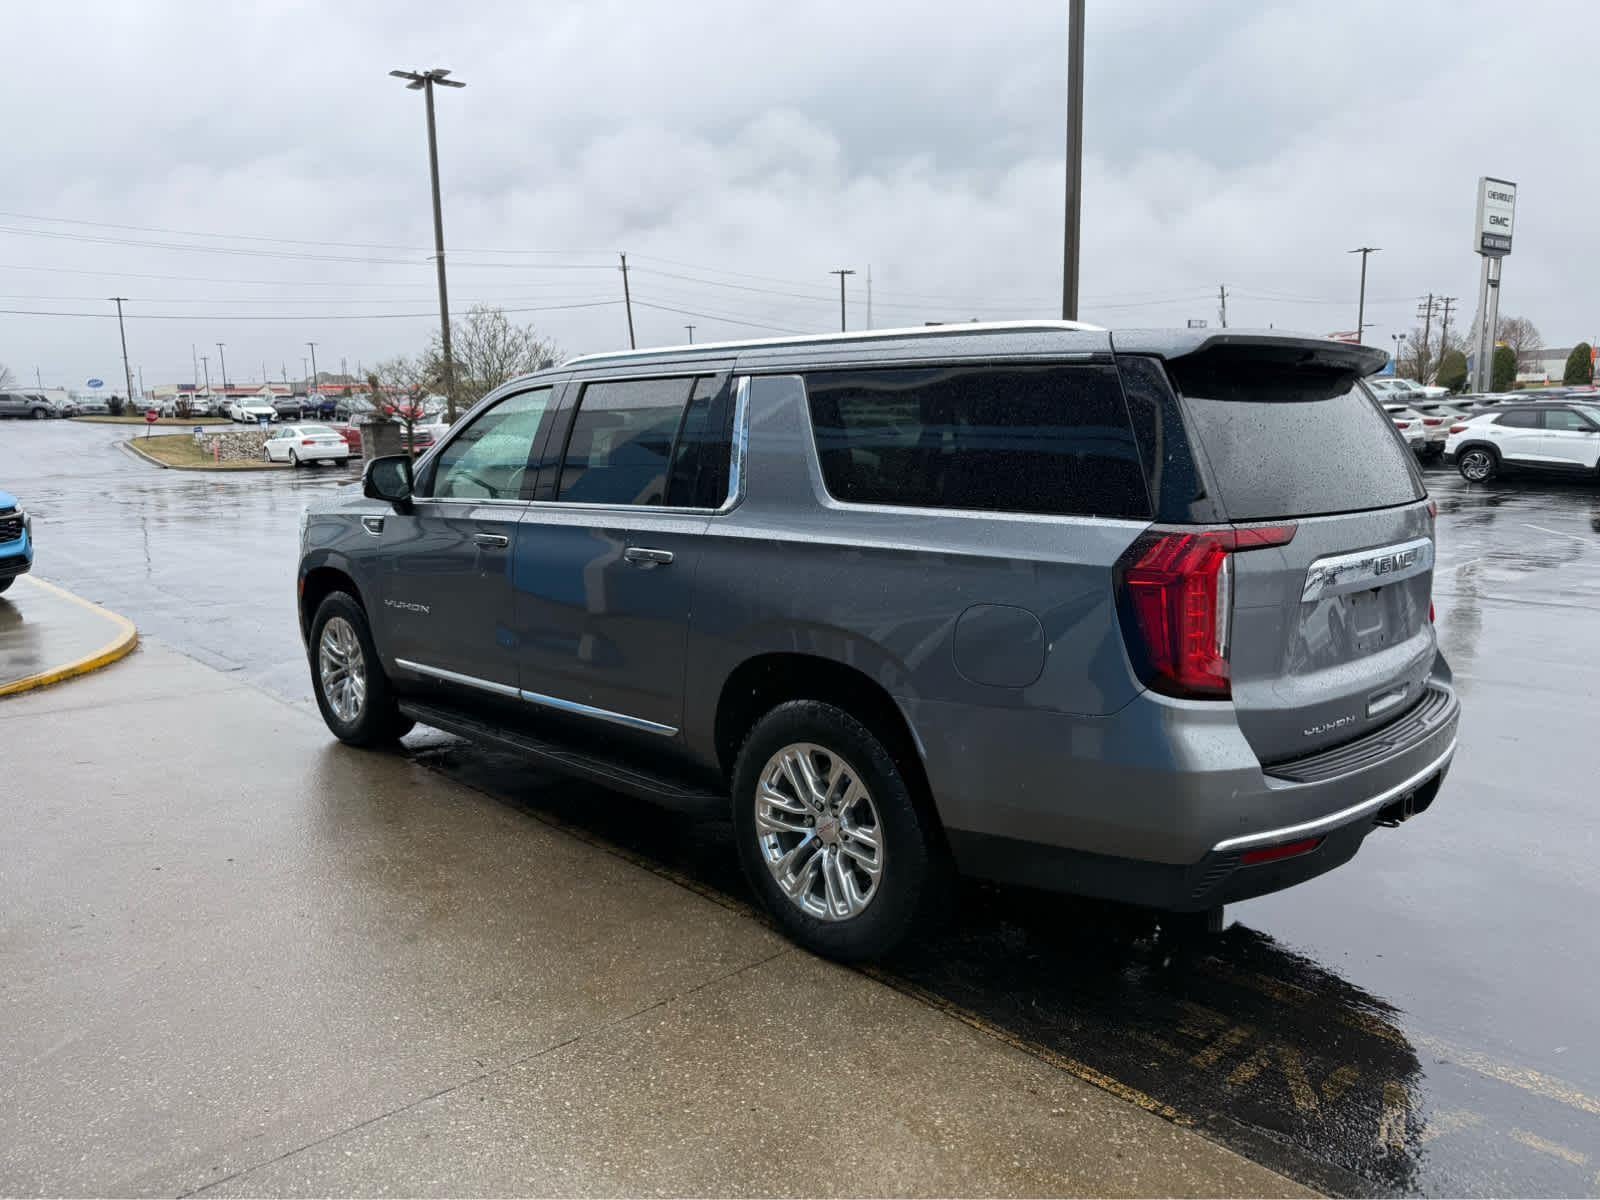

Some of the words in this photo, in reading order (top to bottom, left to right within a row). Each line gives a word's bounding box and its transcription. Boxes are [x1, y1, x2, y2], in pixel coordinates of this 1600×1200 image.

[1487, 190, 1513, 203] CHEVROLET
[1489, 215, 1510, 228] GMC
[1377, 550, 1416, 574] GMC
[383, 599, 430, 614] YUKON
[1303, 714, 1356, 736] YUKON
